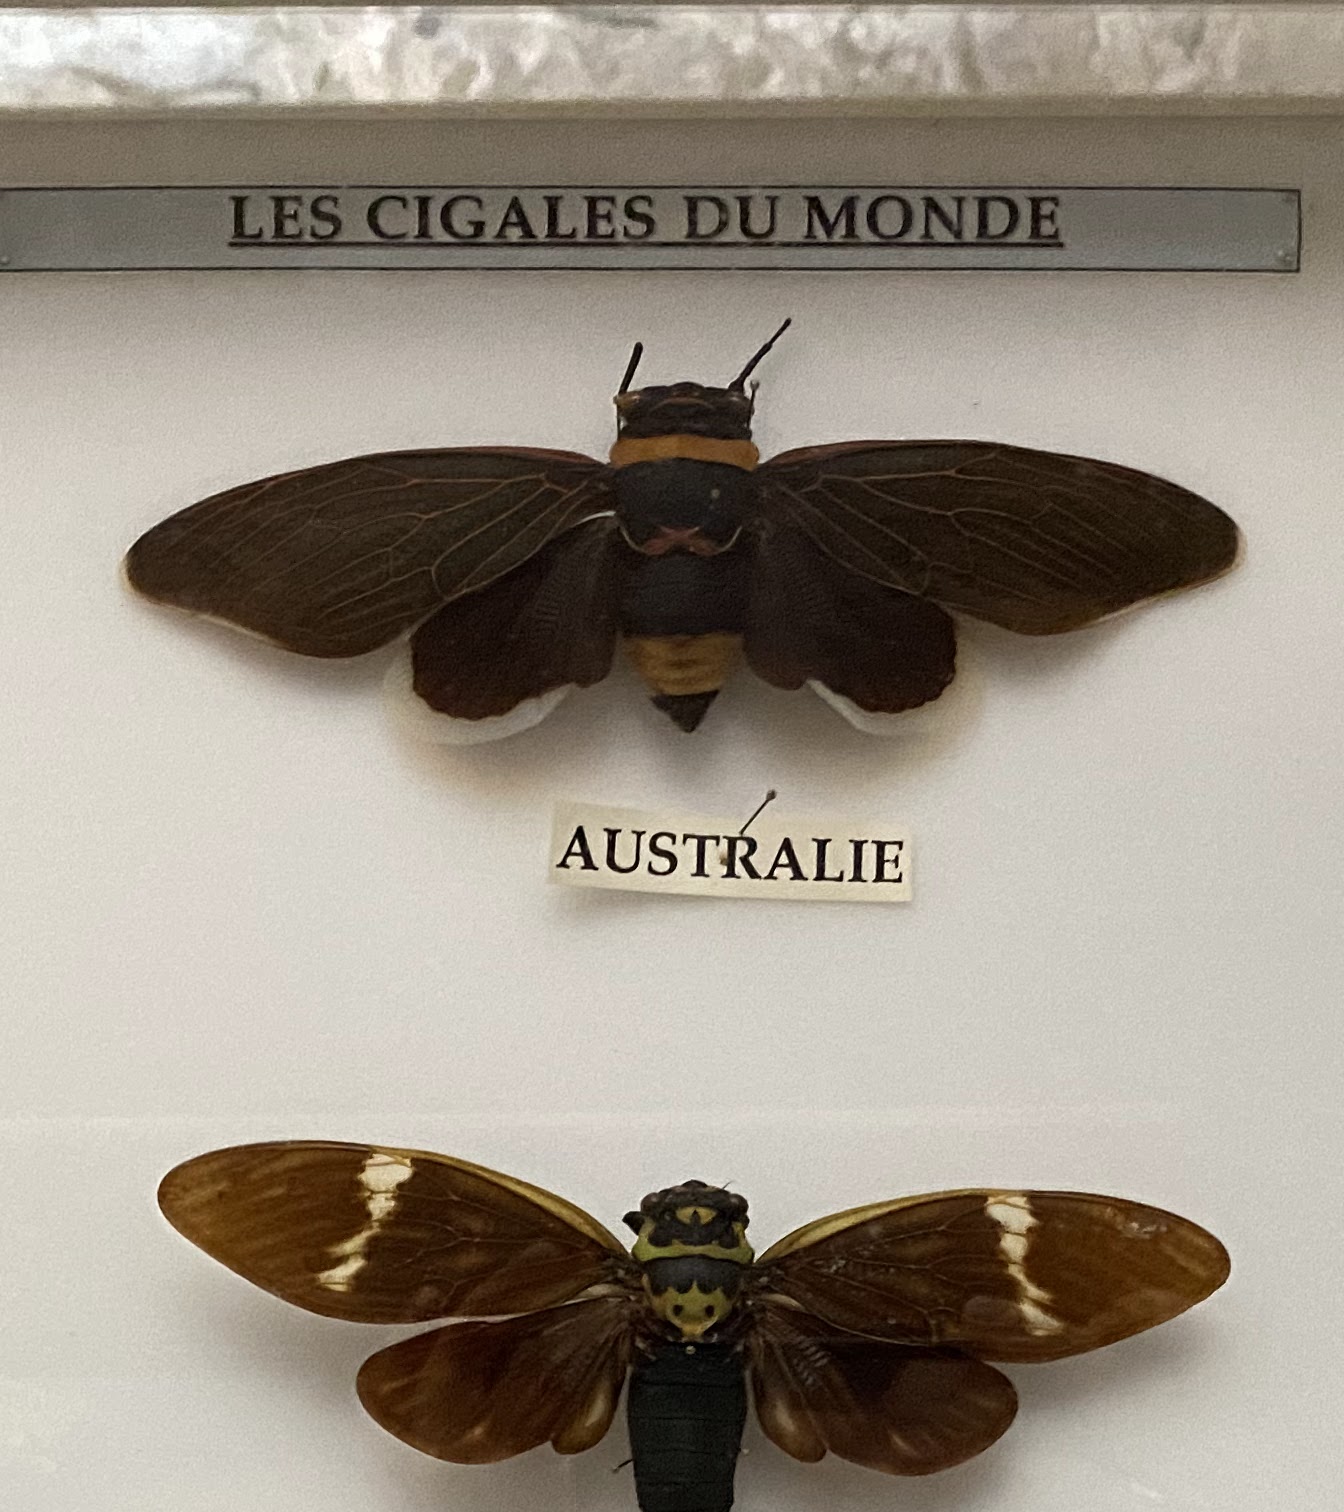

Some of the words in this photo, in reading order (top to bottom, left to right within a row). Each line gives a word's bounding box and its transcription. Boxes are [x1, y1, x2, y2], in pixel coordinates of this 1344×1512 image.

[229, 195, 343, 243] LES
[366, 195, 656, 243] CIGALES
[682, 196, 781, 243] DU
[802, 196, 1064, 244] MONDE
[556, 825, 905, 884] AUSTRALIE
